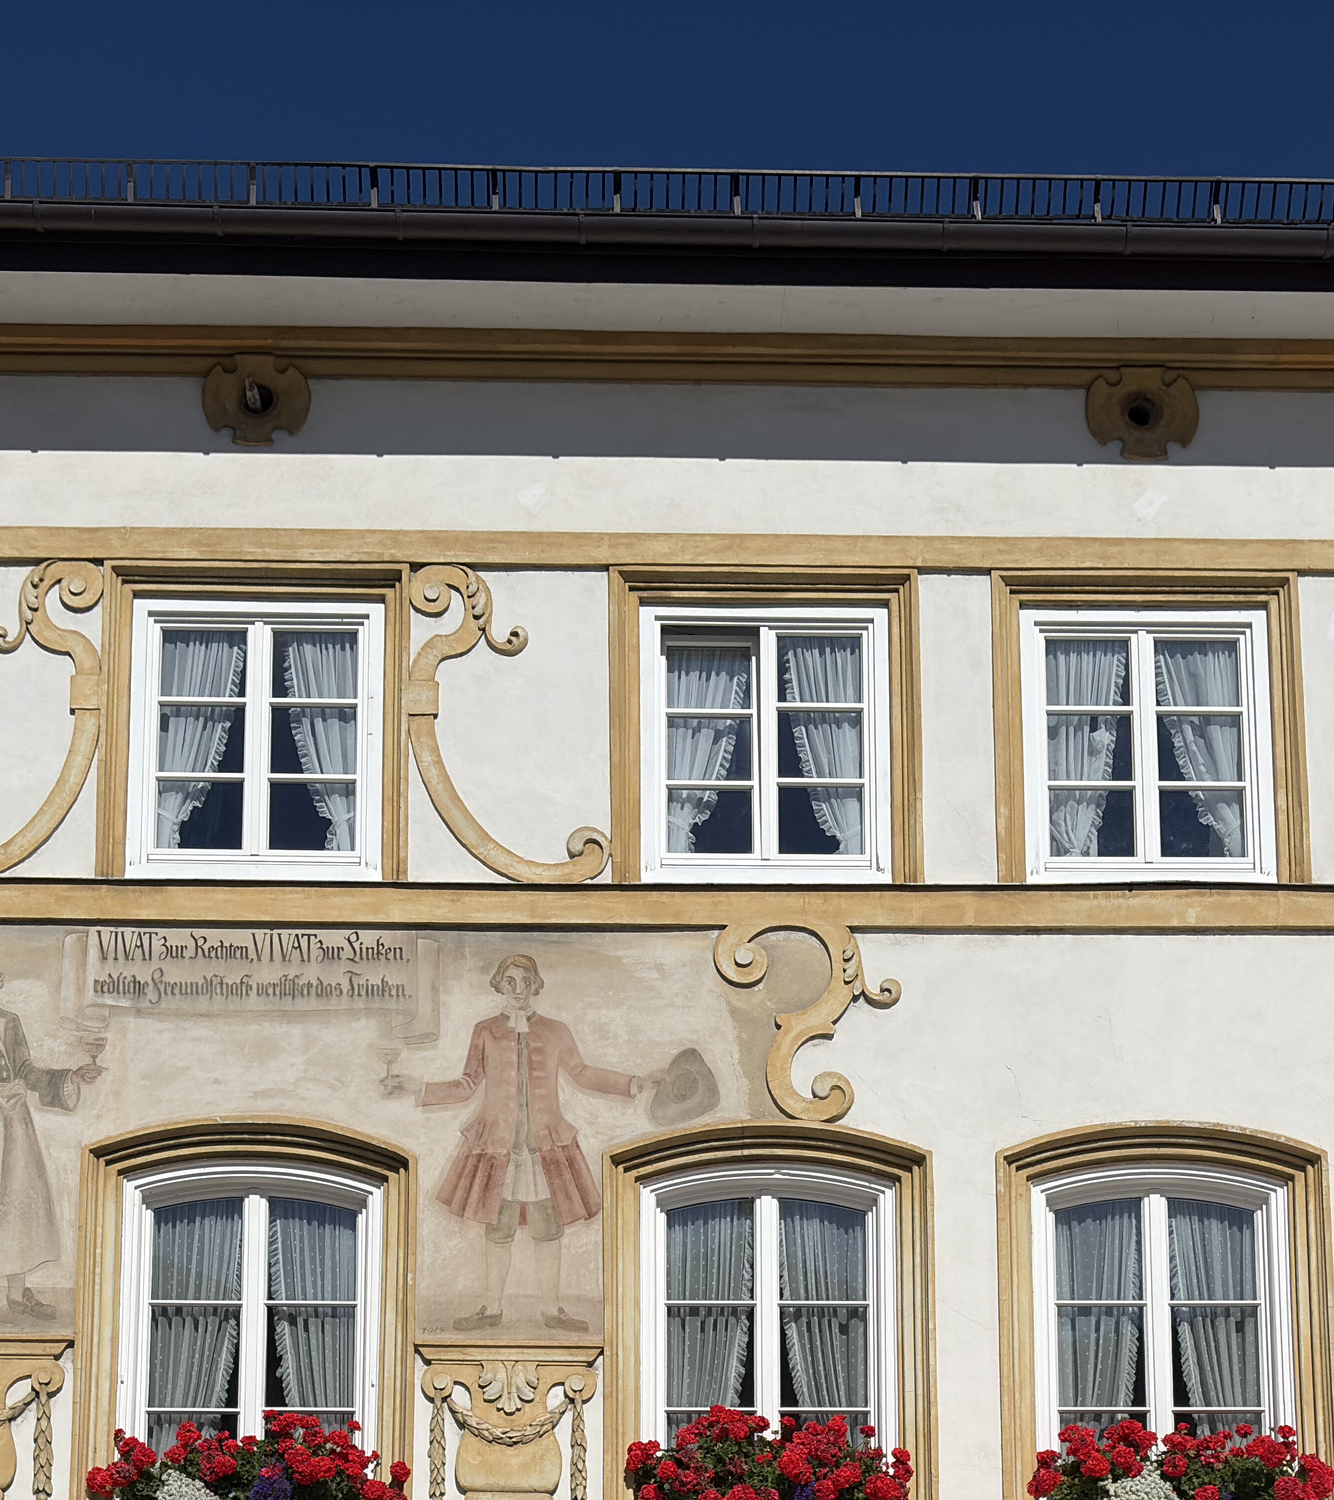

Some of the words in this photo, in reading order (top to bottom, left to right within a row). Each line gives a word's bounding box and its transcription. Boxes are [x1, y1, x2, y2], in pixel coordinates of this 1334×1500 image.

[96, 930, 158, 961] VIVAT
[251, 932, 317, 963] VIVAT
[94, 972, 149, 1000] redliche
[149, 967, 253, 1004] Freundschaft
[315, 977, 343, 998] das
